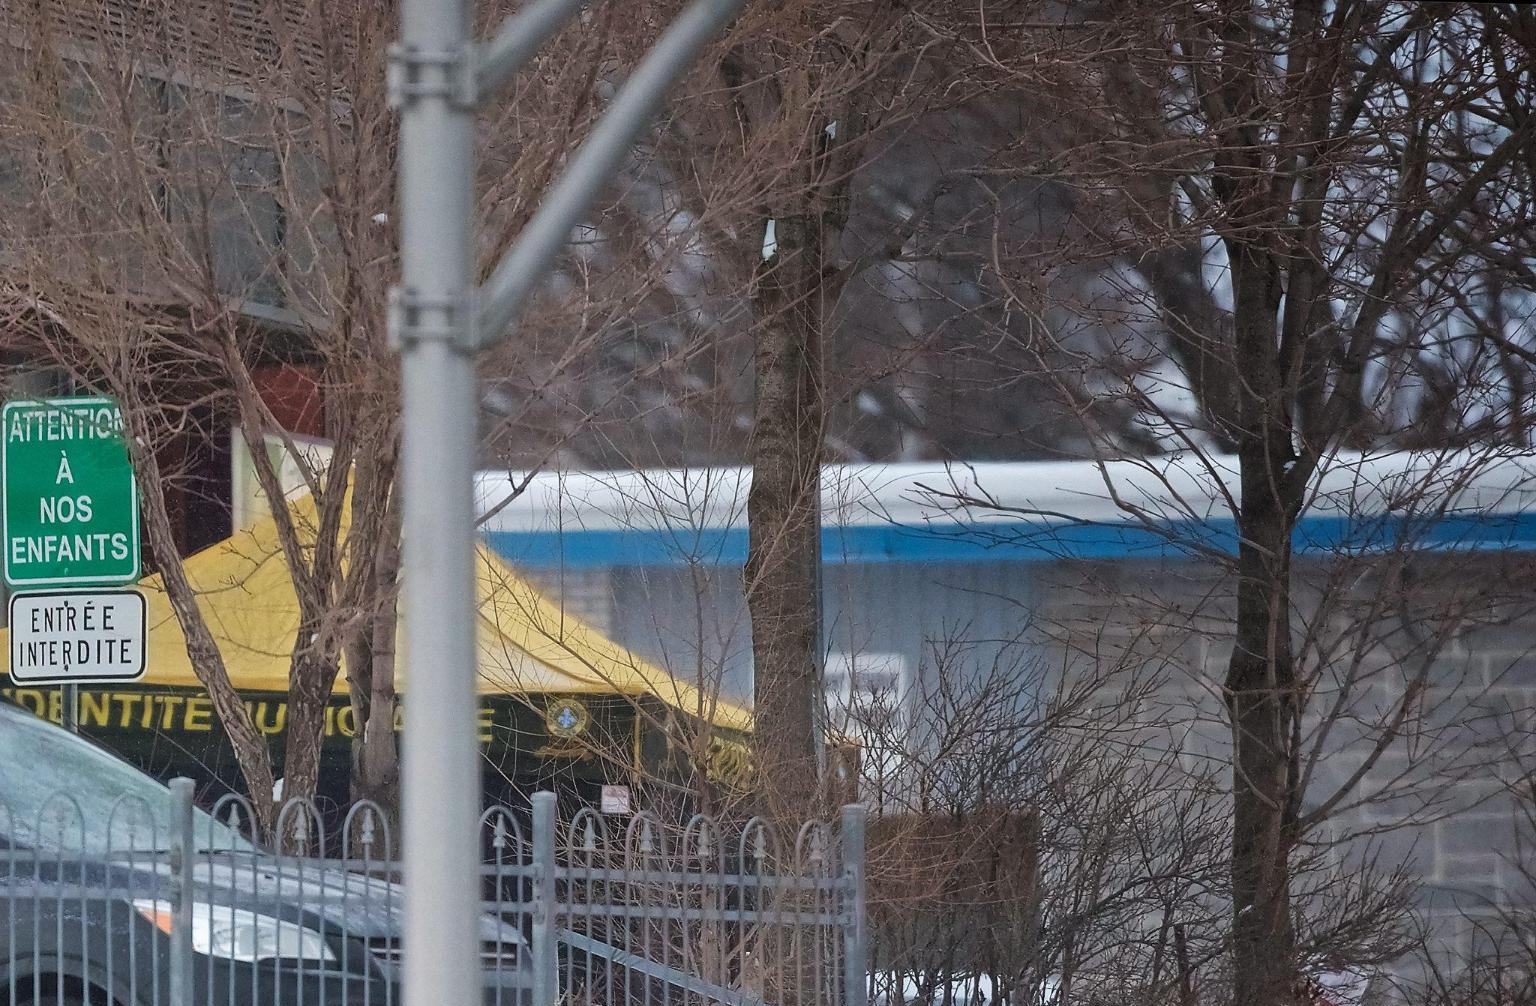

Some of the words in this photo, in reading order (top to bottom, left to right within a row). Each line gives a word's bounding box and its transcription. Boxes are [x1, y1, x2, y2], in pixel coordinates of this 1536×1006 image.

[9, 408, 124, 443] ATTENTION
[55, 450, 74, 485] À
[40, 495, 93, 524] NOS
[12, 533, 128, 564] ENFANTS
[31, 600, 115, 633] ENTRÉE
[20, 639, 132, 667] INTERDITE
[2, 687, 212, 731] DENTITÉ
